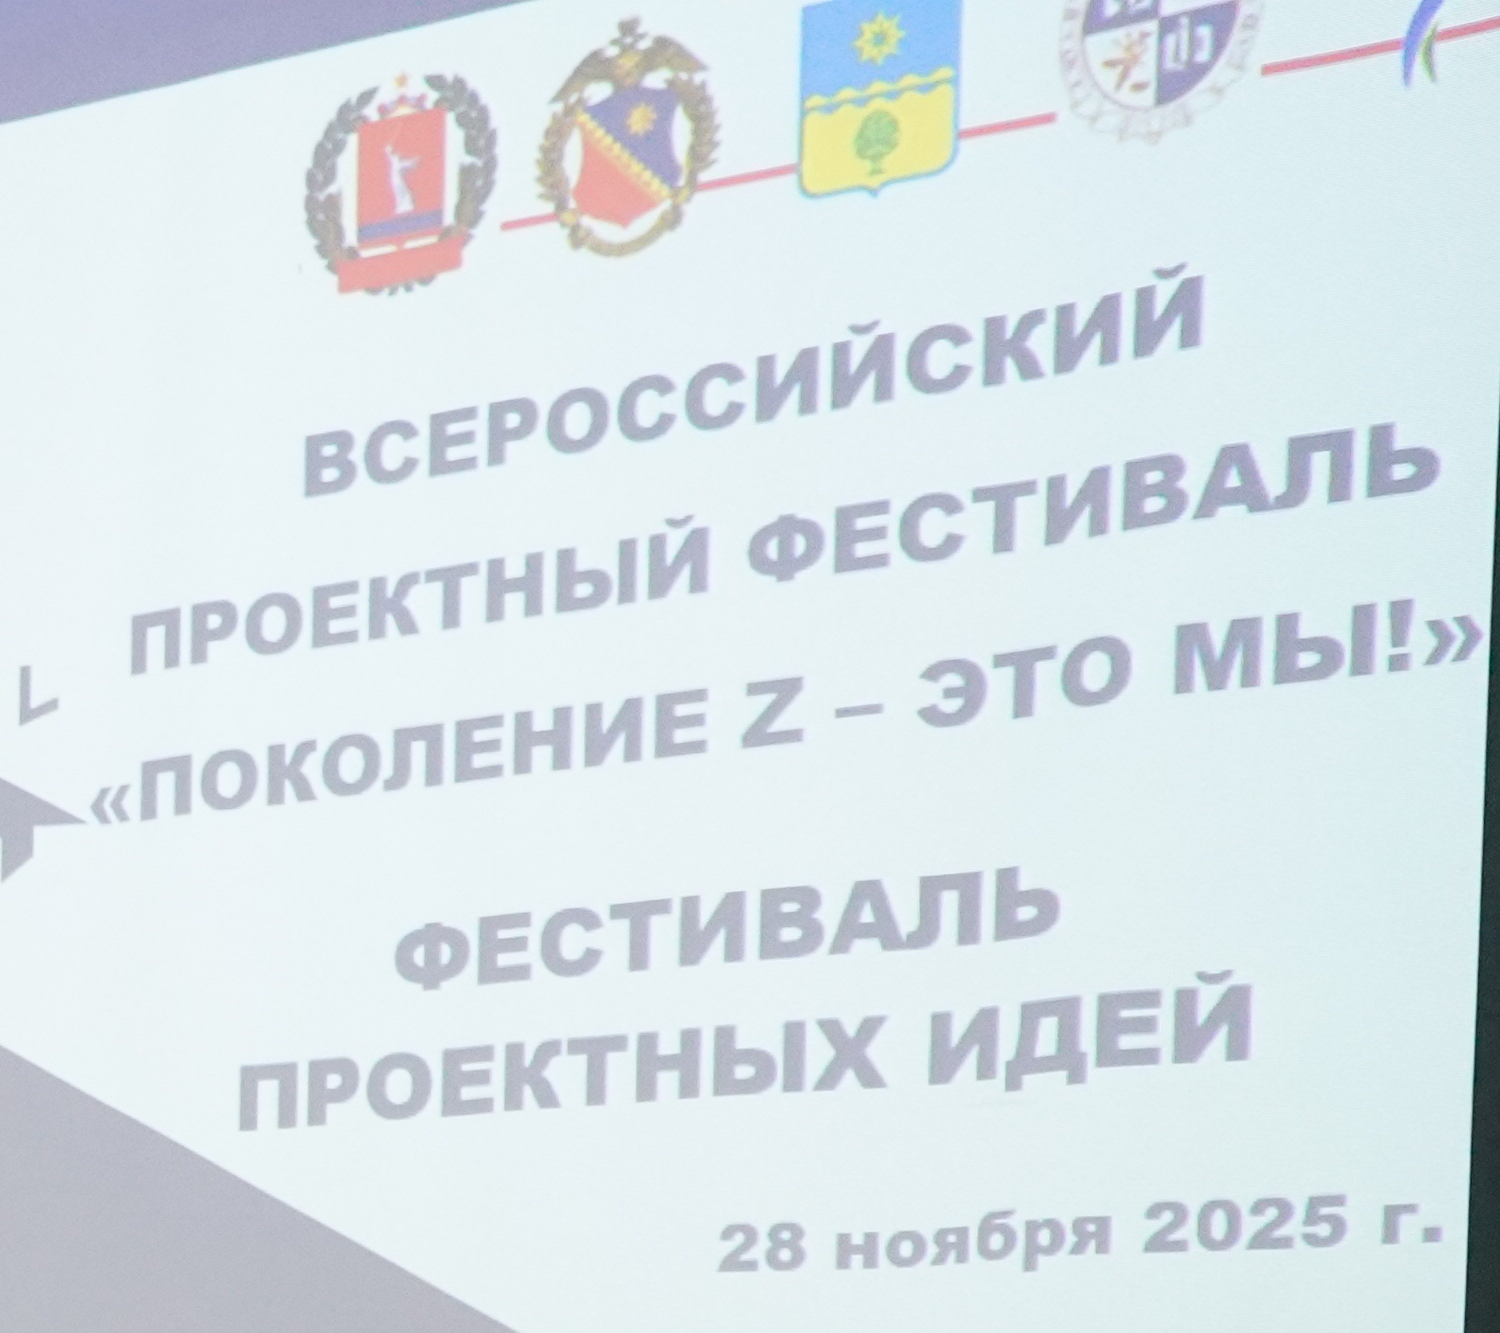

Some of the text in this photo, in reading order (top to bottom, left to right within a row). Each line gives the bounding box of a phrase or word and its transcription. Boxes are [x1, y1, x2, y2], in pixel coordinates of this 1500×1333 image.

[302, 262, 1205, 498] ВСЕРОССИЙСКИЙ
[129, 421, 1442, 676] ПРОЕКТНЫЙ ФЕСТИВАЛЬ
[89, 689, 709, 828] «ПОКОЛЕНИЕ
[740, 677, 804, 750] Z
[916, 636, 1131, 729] ЭТО
[1174, 597, 1485, 695] МЫ!»
[394, 865, 1062, 992] ФЕСТИВАЛЬ
[238, 969, 1254, 1132] ПРОЕКТНЫХ ИДЕЙ
[717, 1194, 1446, 1275] 28 ноября 2025 г.
